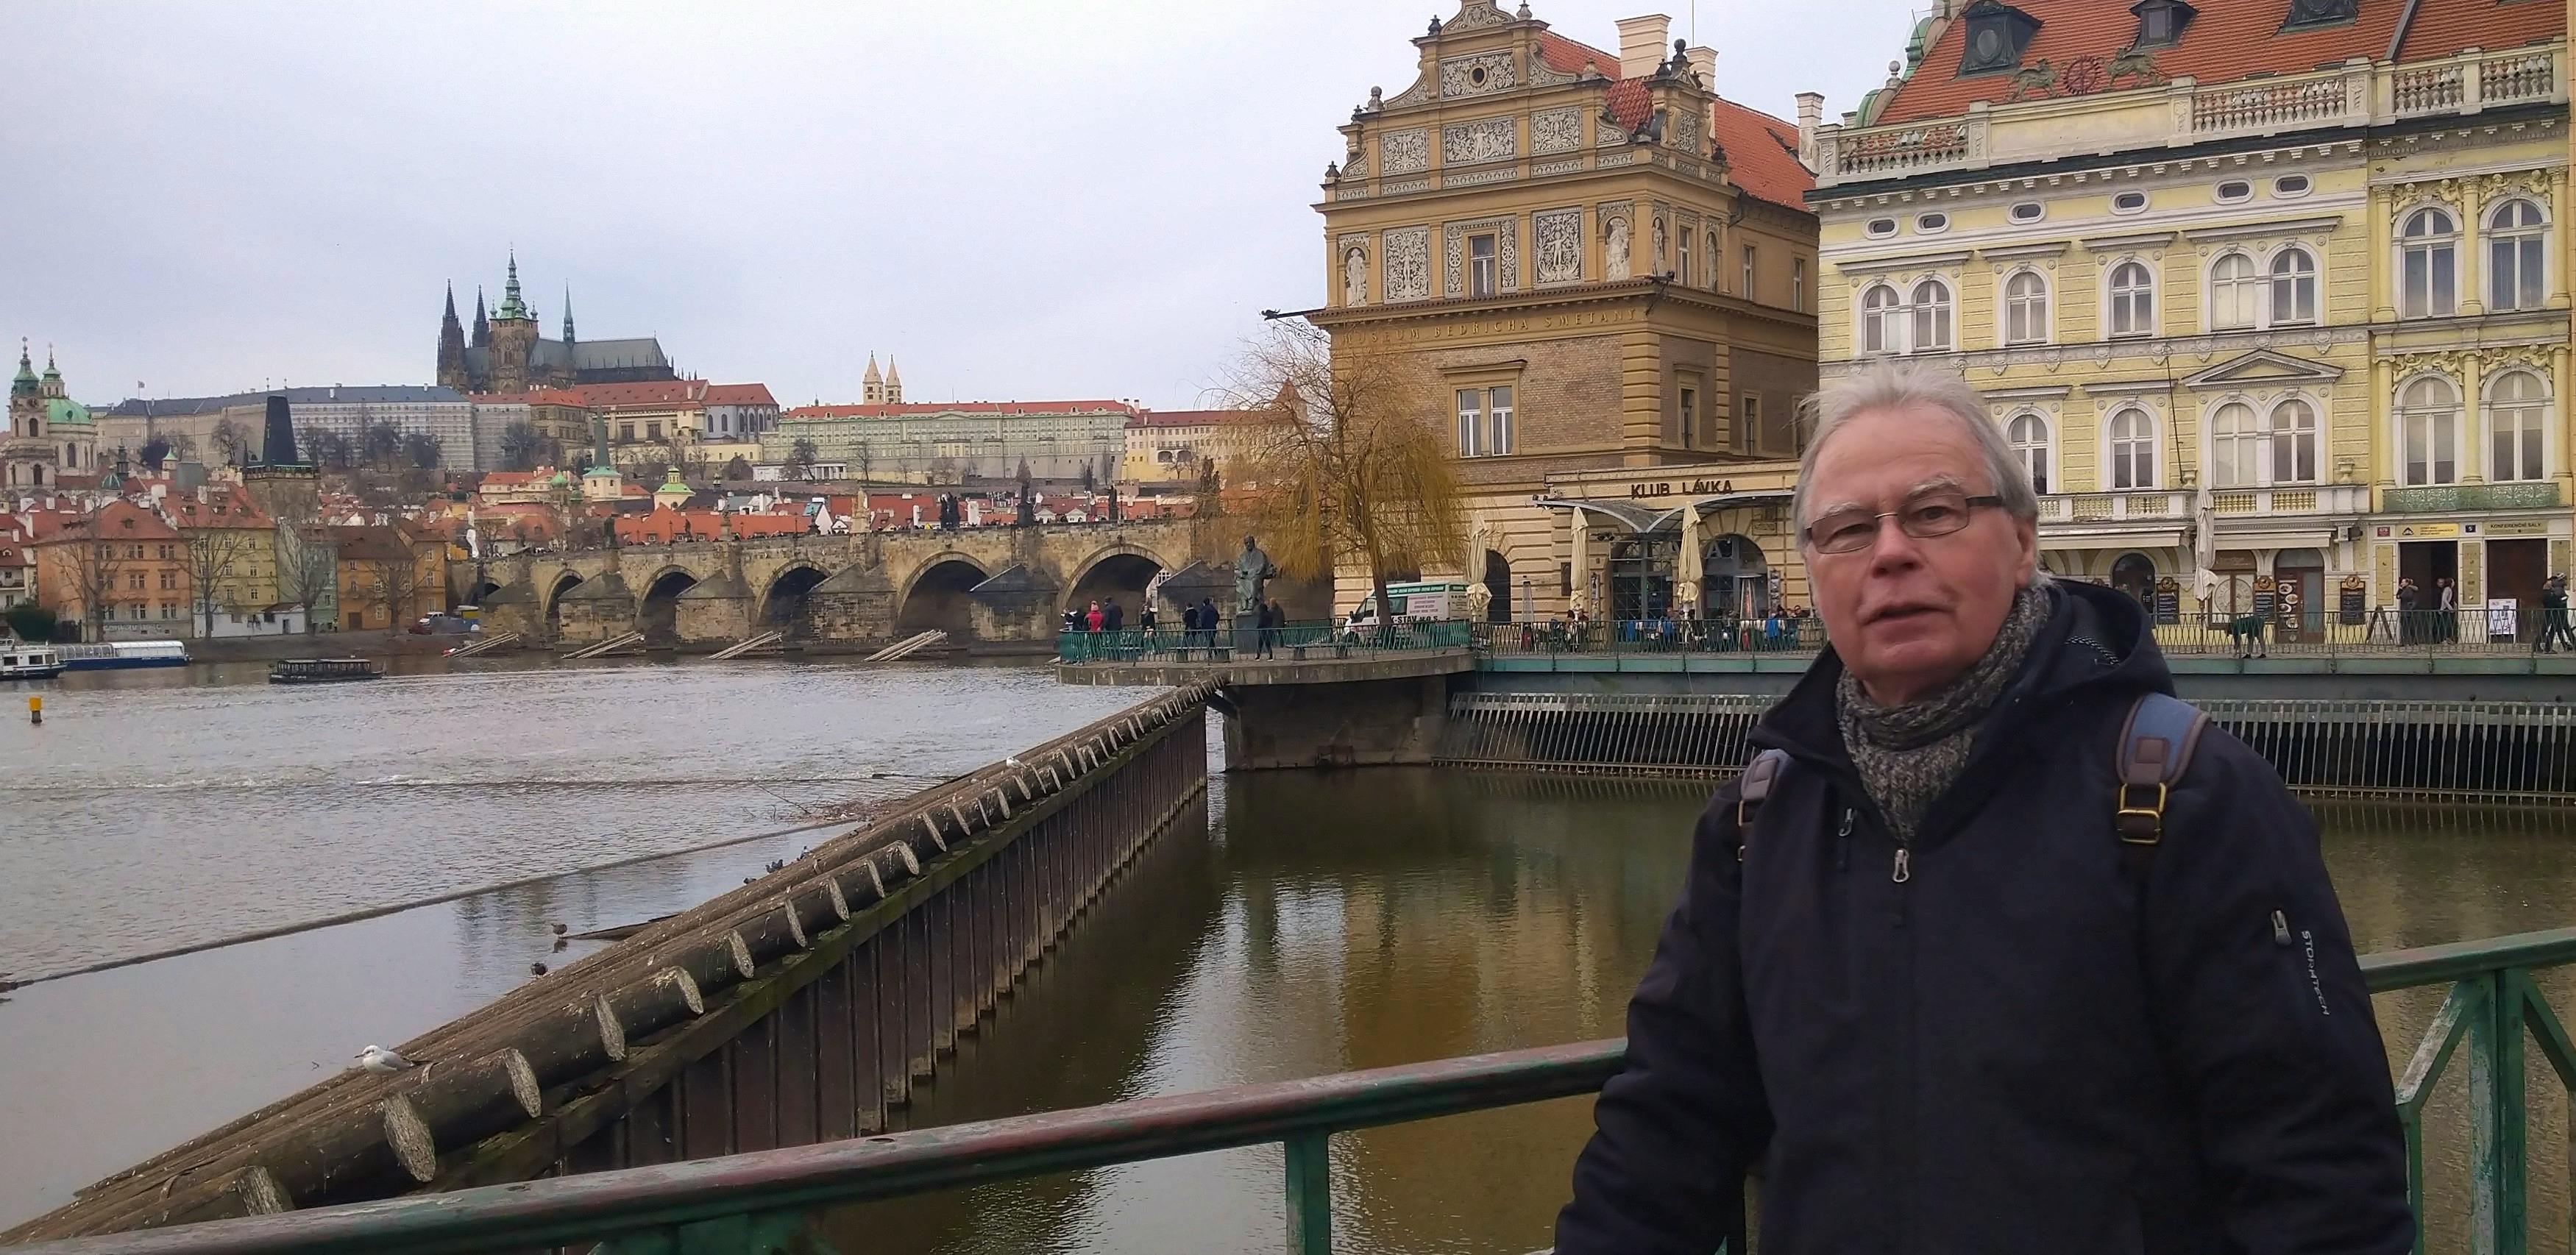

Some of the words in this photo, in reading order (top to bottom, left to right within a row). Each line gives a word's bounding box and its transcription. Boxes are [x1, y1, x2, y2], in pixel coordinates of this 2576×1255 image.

[1544, 309, 1636, 327] SMETANY
[1631, 483, 1670, 499] KLUB
[1682, 478, 1734, 495] LÁVKA
[2301, 929, 2331, 1016] STORMTECH
